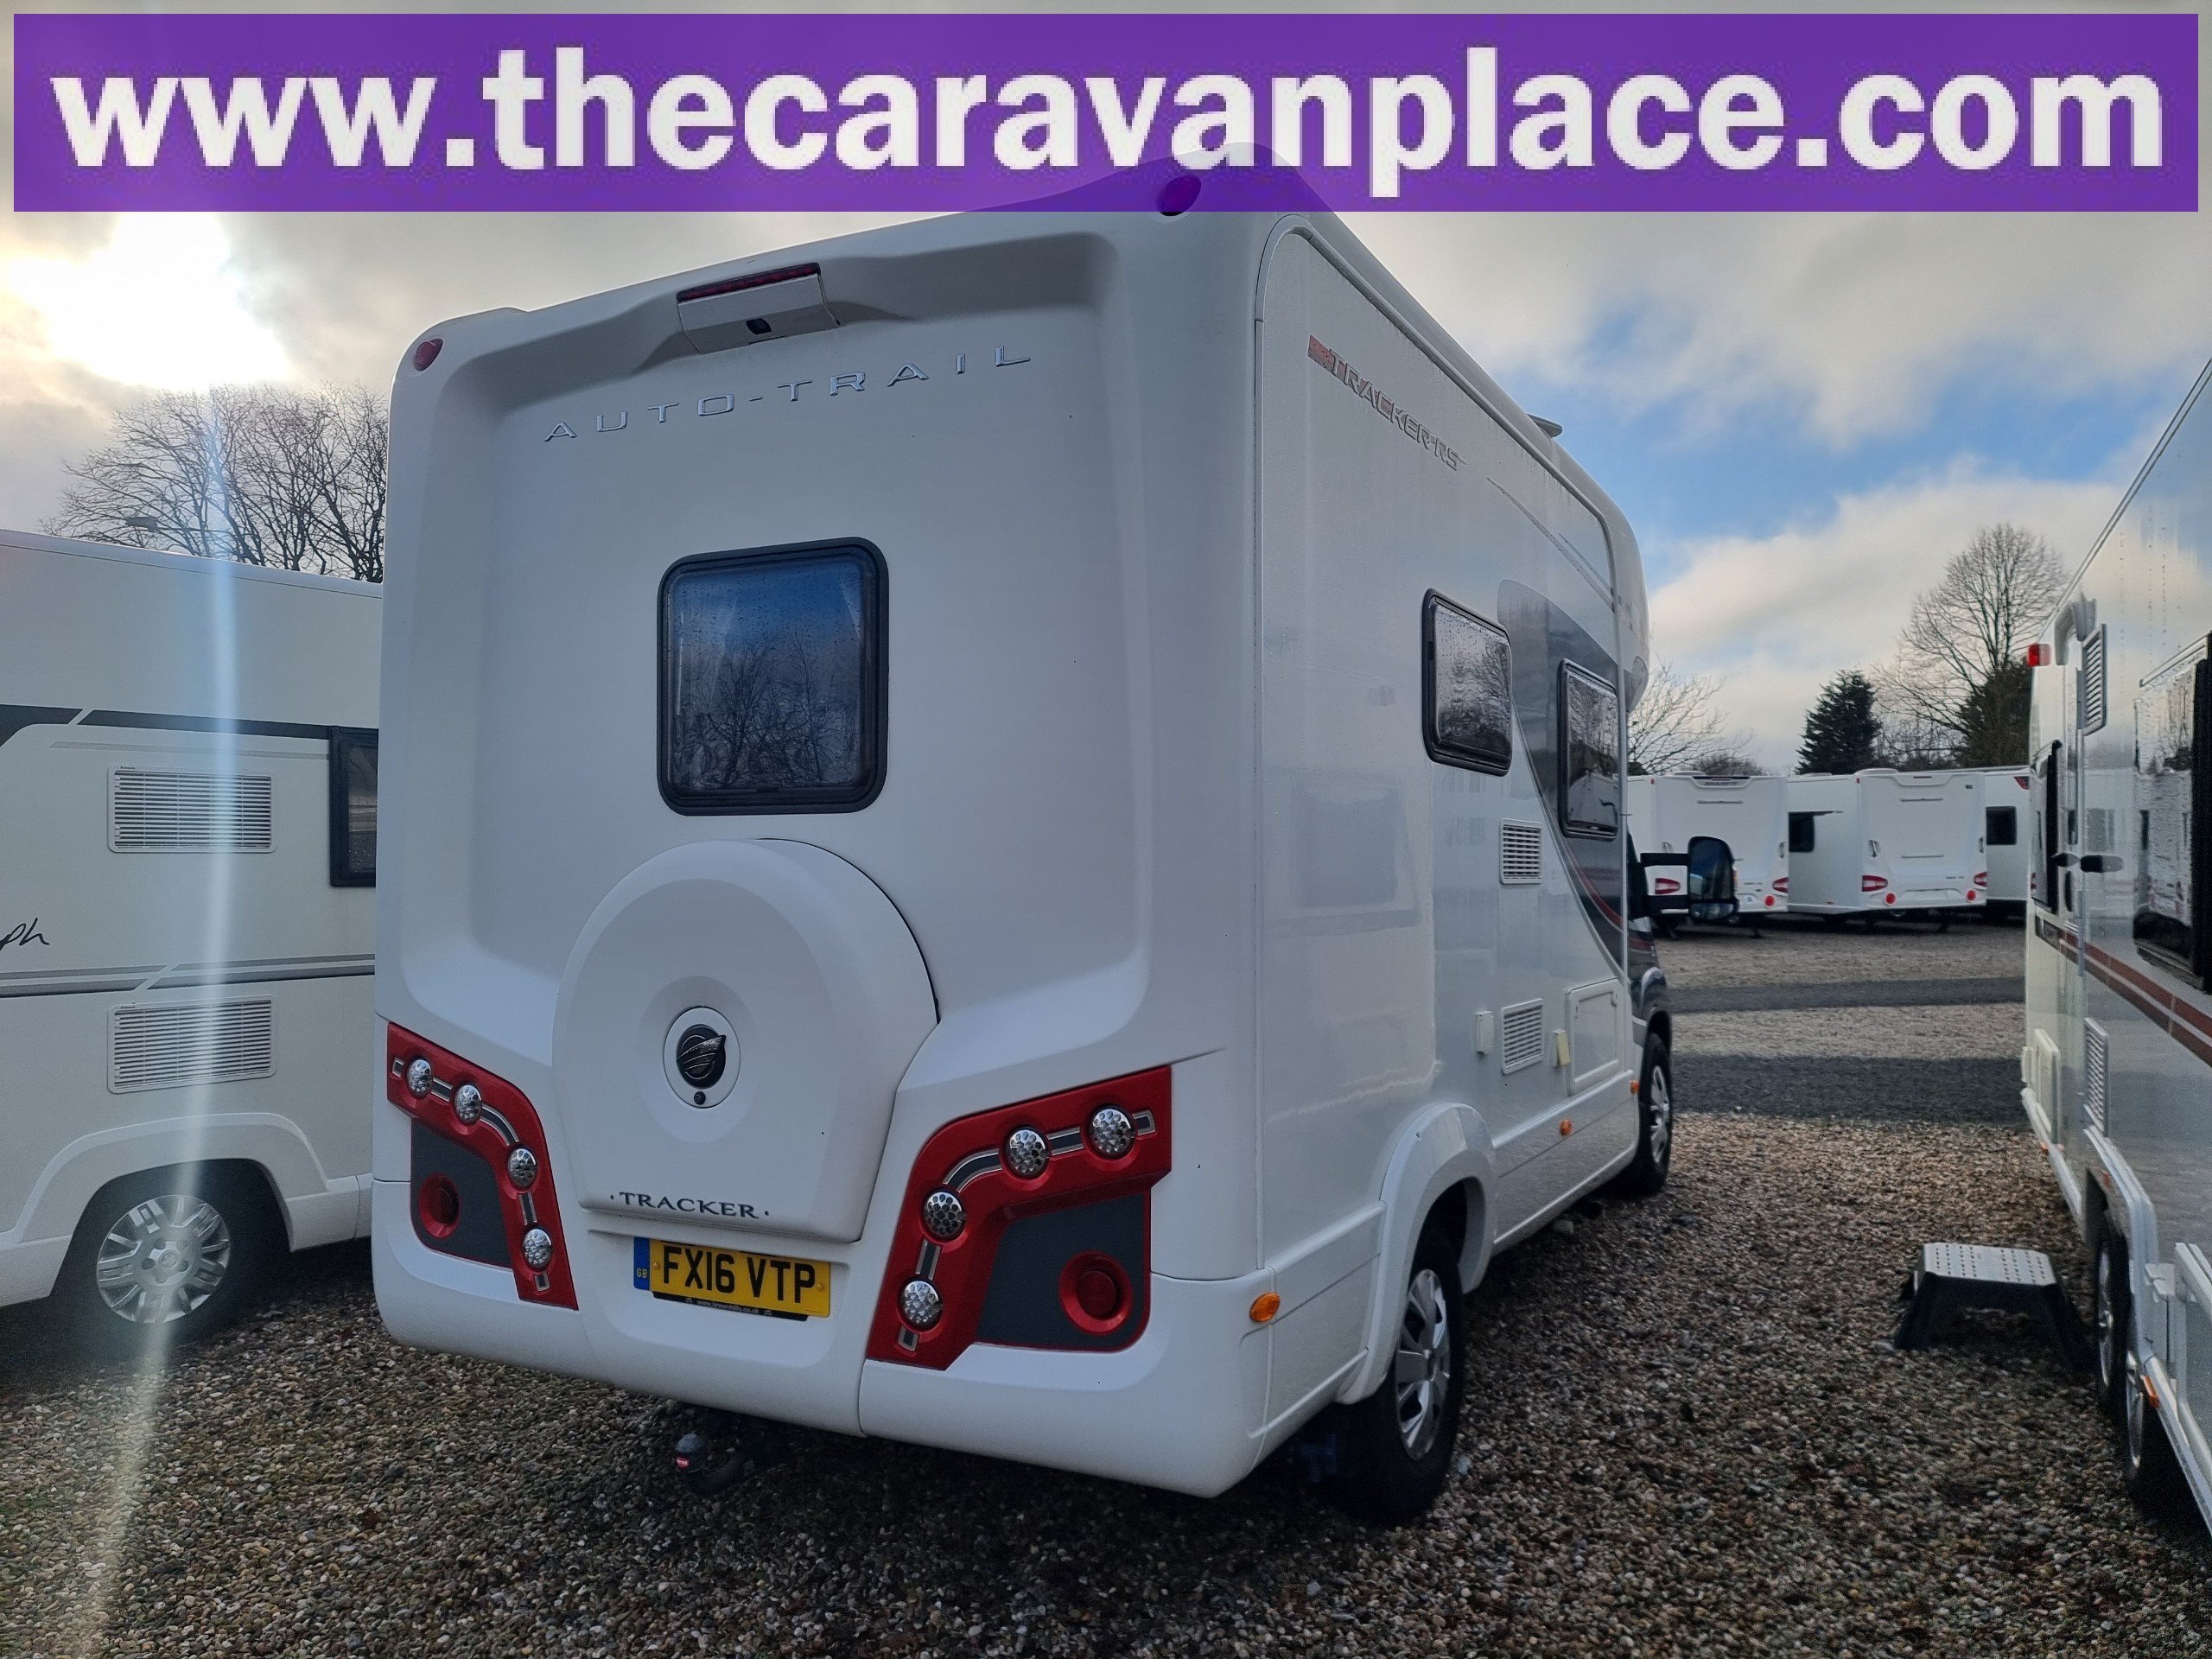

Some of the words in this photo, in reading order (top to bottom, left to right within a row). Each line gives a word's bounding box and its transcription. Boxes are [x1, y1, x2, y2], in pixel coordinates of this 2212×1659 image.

[544, 346, 1031, 442] AUTO-TRAIL
[619, 1192, 760, 1219] TRACKER
[636, 1268, 647, 1279] GB
[663, 1245, 735, 1294] FX16
[746, 1256, 816, 1303] VTP
